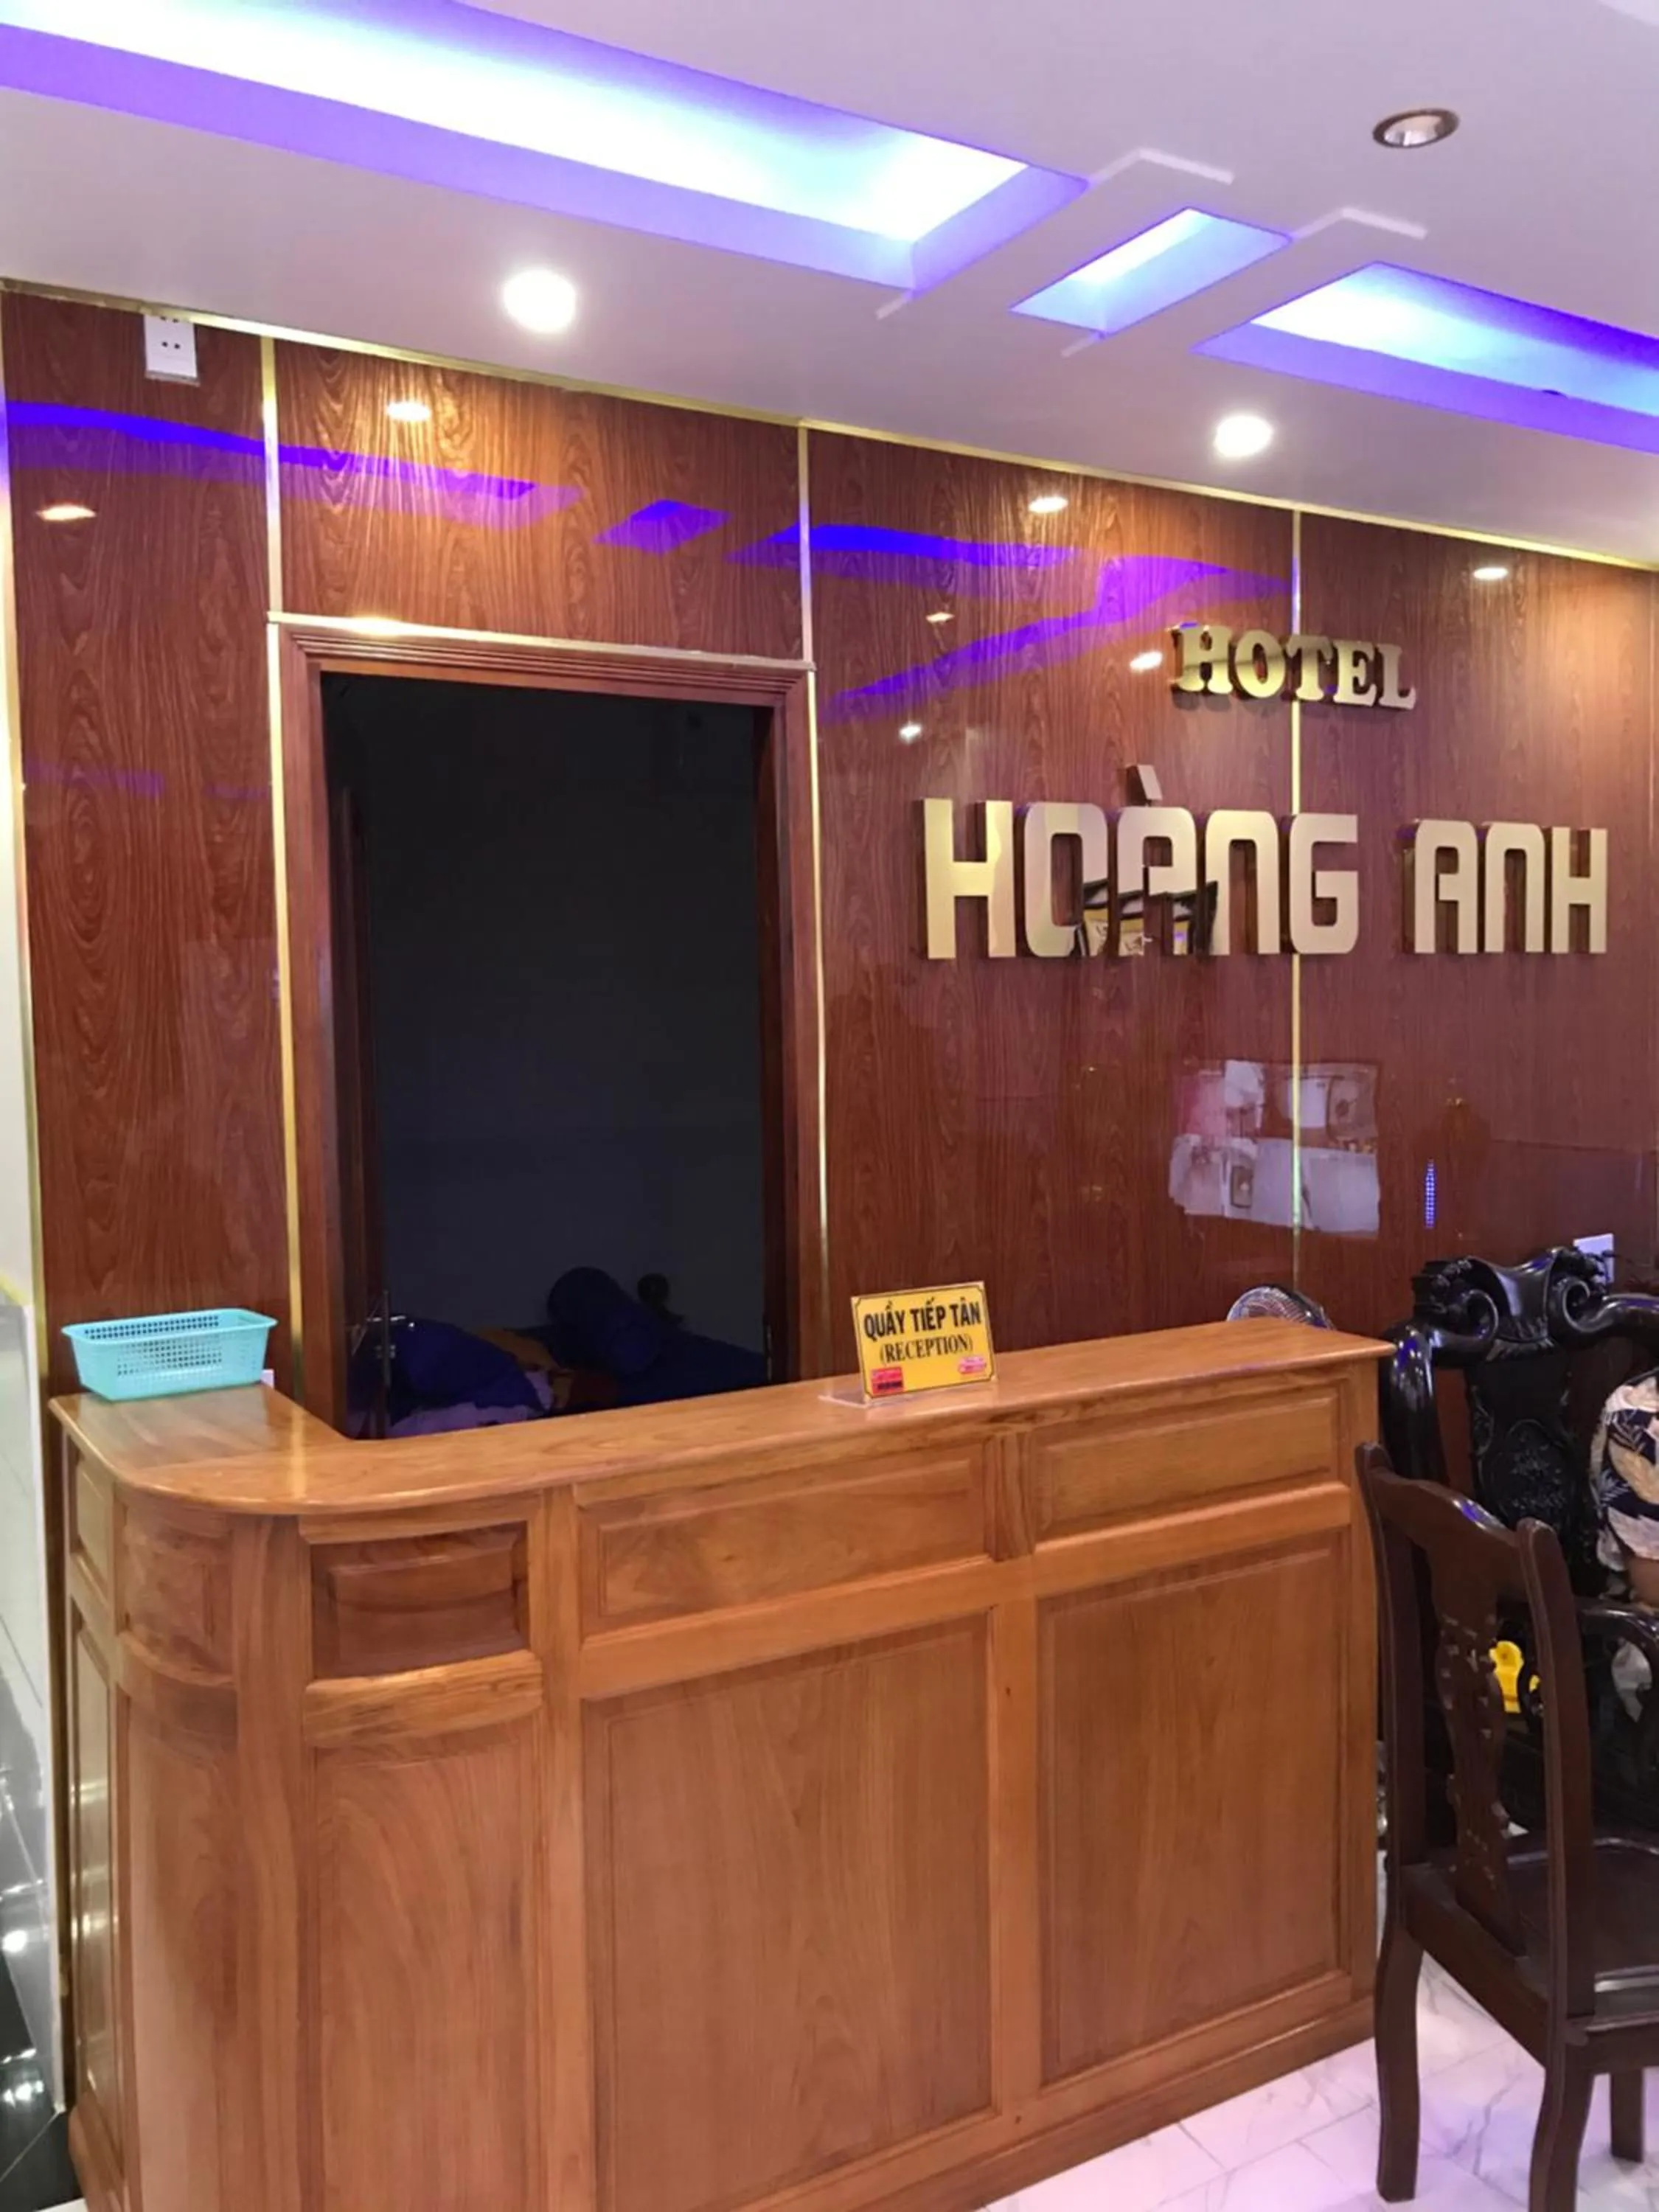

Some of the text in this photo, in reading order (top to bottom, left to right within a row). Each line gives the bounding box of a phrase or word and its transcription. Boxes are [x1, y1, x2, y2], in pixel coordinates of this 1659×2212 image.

[1174, 625, 1416, 710] HOTEL
[924, 764, 1608, 959] HOÀNG ANH
[910, 1297, 946, 1332] TIẾP
[949, 1297, 981, 1326] TÂN
[880, 1333, 973, 1363] (RECEPTION)
